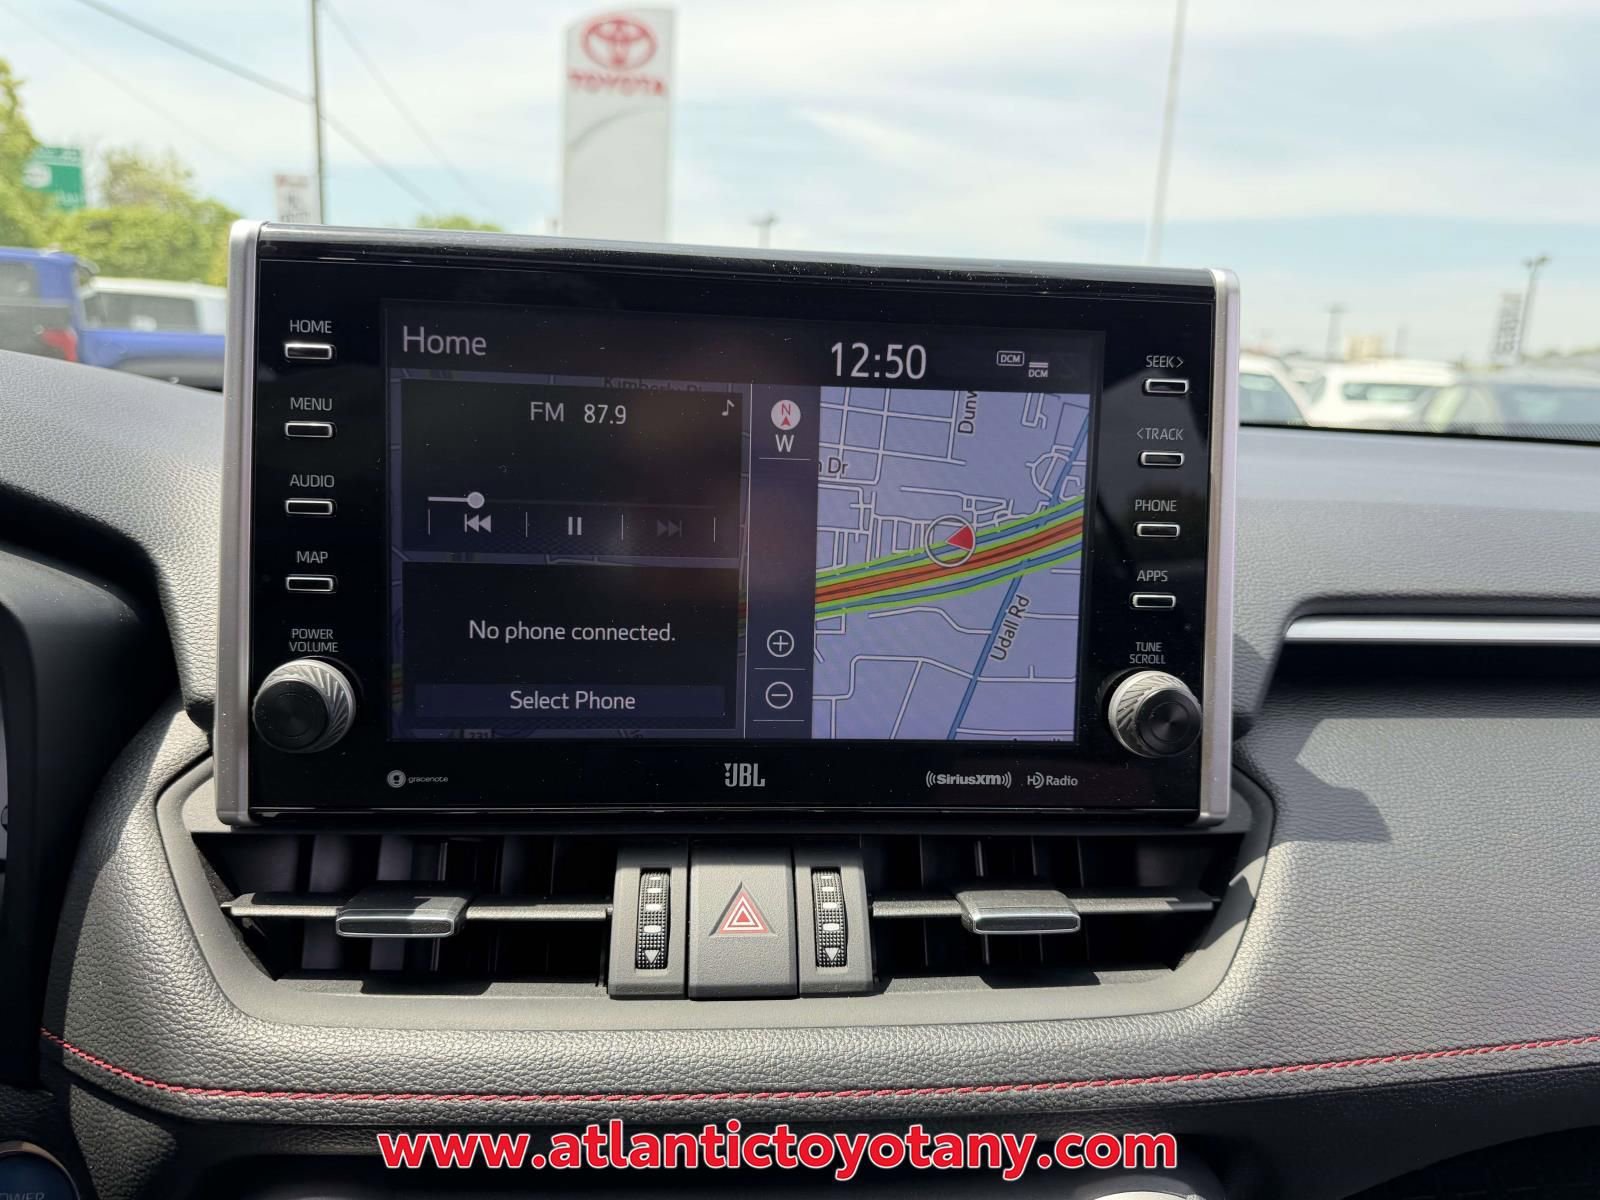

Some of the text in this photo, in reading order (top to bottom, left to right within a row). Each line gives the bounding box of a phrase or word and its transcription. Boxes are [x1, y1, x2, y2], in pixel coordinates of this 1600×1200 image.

[289, 319, 333, 334] HOME
[402, 325, 487, 356] Home
[830, 342, 927, 380] 12:50
[1000, 353, 1021, 364] DCM
[1028, 368, 1048, 378] DCM
[289, 397, 333, 411] MENU
[780, 403, 792, 416] N
[529, 401, 627, 425] FM 87.9
[774, 434, 795, 453] W
[828, 456, 849, 475] Dr
[289, 474, 335, 488] AUDIO
[1134, 499, 1177, 512] PHONE
[296, 551, 329, 564] MAP
[1136, 569, 1168, 582] APPS
[291, 628, 334, 640] POWER
[468, 619, 677, 644] No phone connected.
[989, 594, 1030, 661] Udall Rd
[289, 641, 339, 653] VOLUME
[1135, 641, 1163, 652] TUNE
[1129, 653, 1166, 665] SCROLL
[509, 689, 636, 710] Select Phone
[724, 762, 766, 788] JBL
[1046, 775, 1079, 787] Radio
